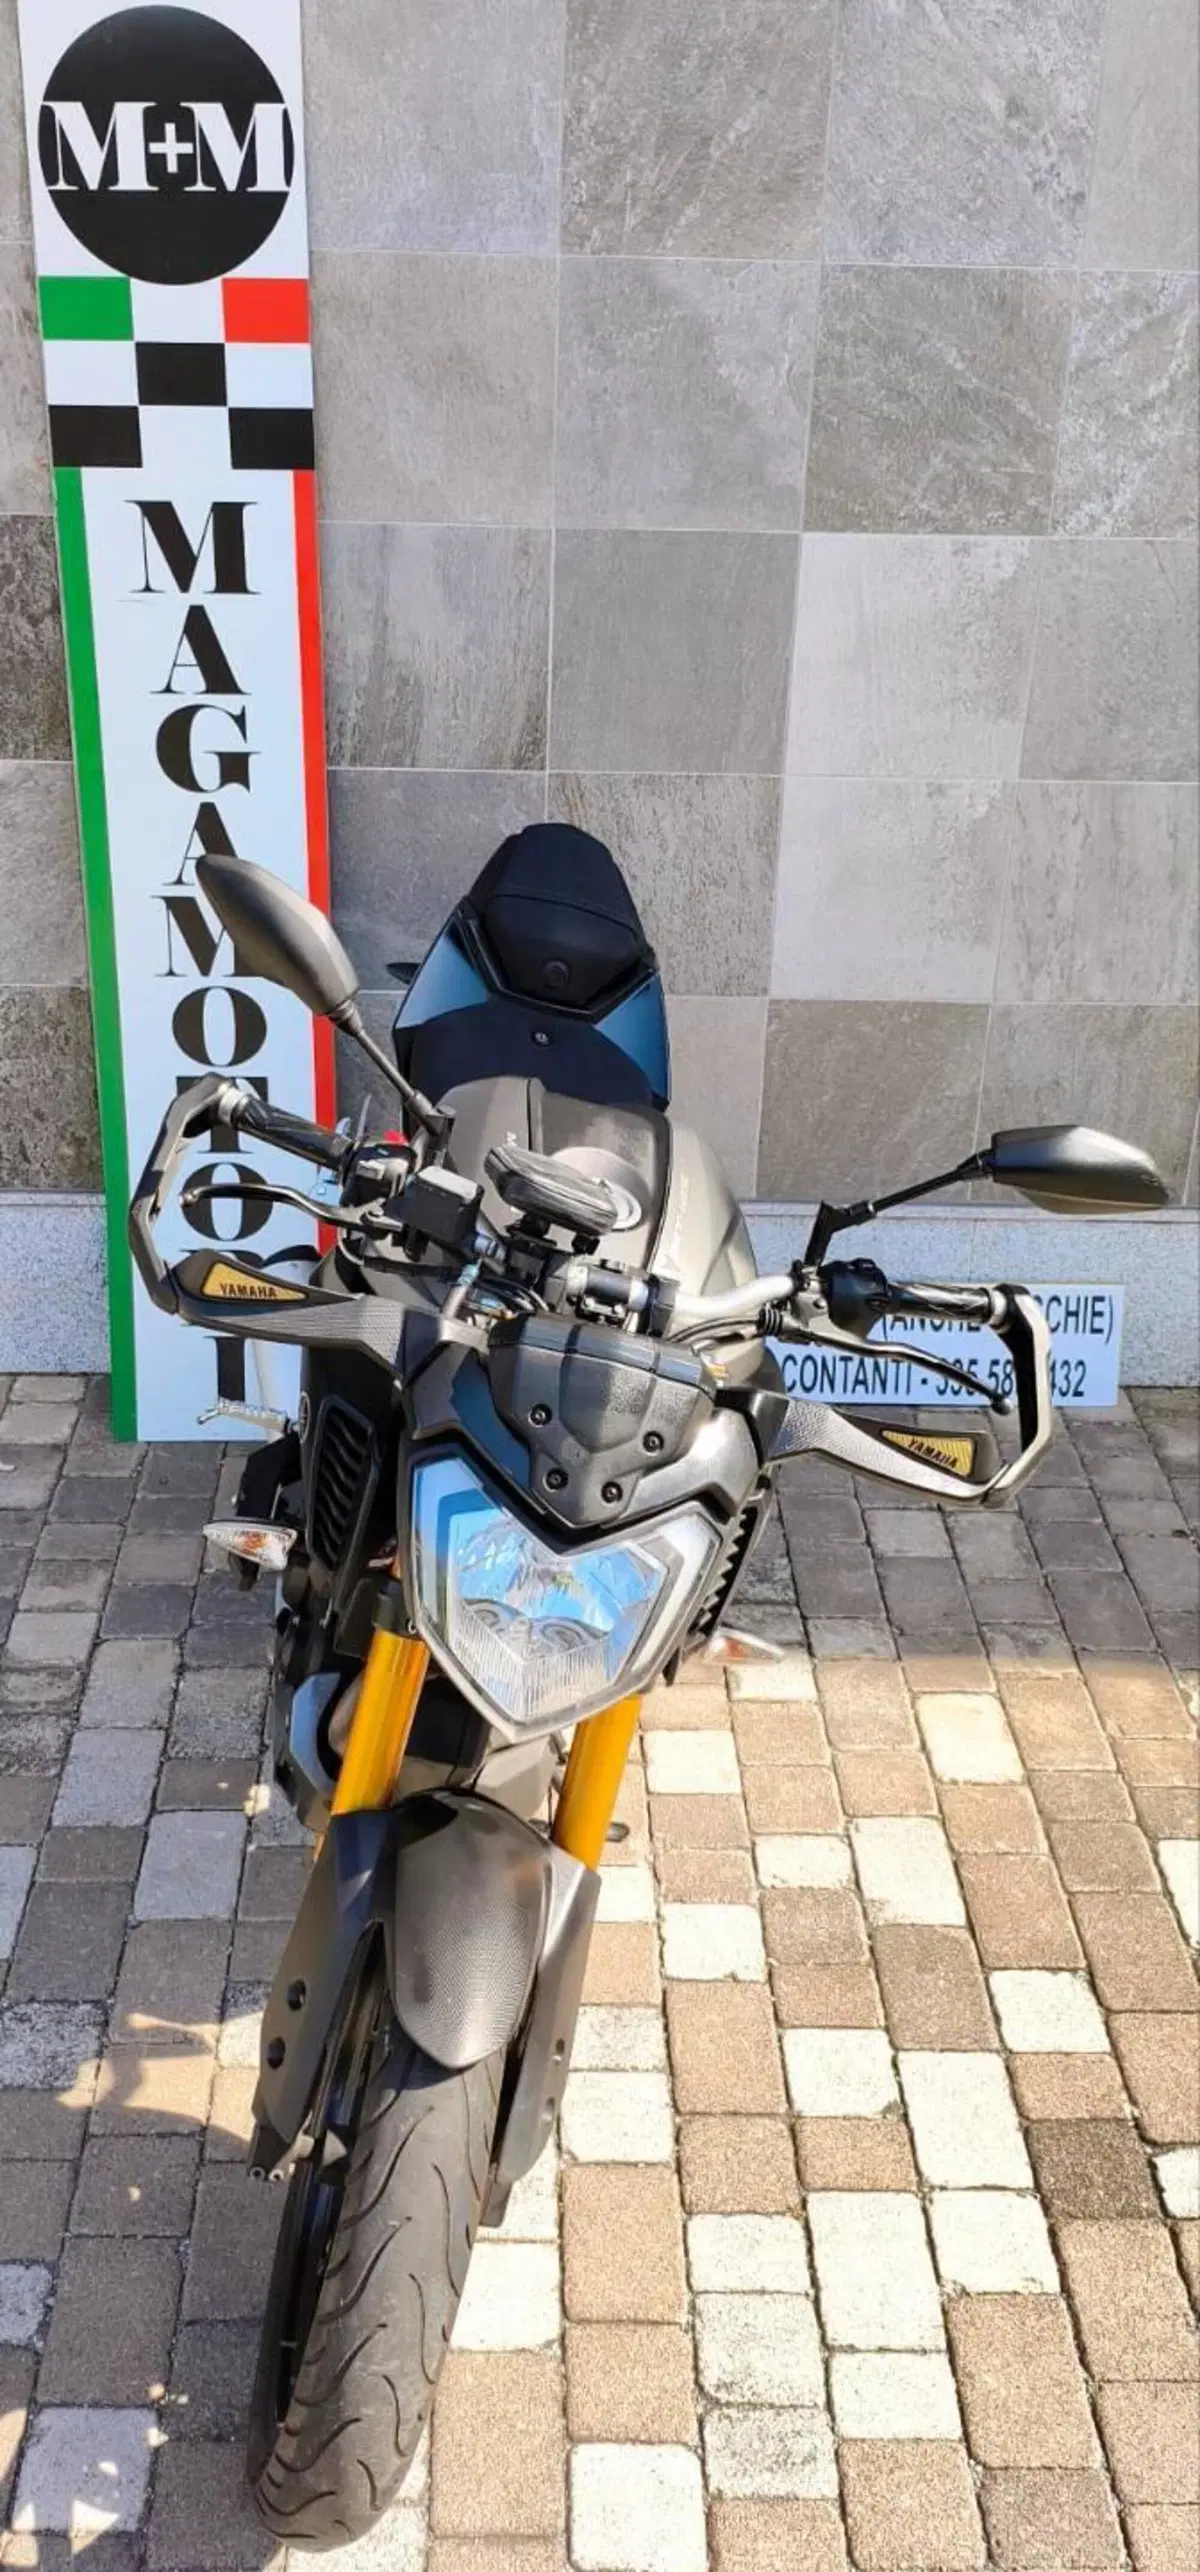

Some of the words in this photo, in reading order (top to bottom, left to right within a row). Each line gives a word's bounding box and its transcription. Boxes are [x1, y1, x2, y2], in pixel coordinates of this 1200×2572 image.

[41, 101, 292, 192] M+M
[219, 1283, 279, 1298] YAMAHA
[781, 1354, 912, 1396] CONTANTI
[907, 1437, 958, 1468] YAMAHA
